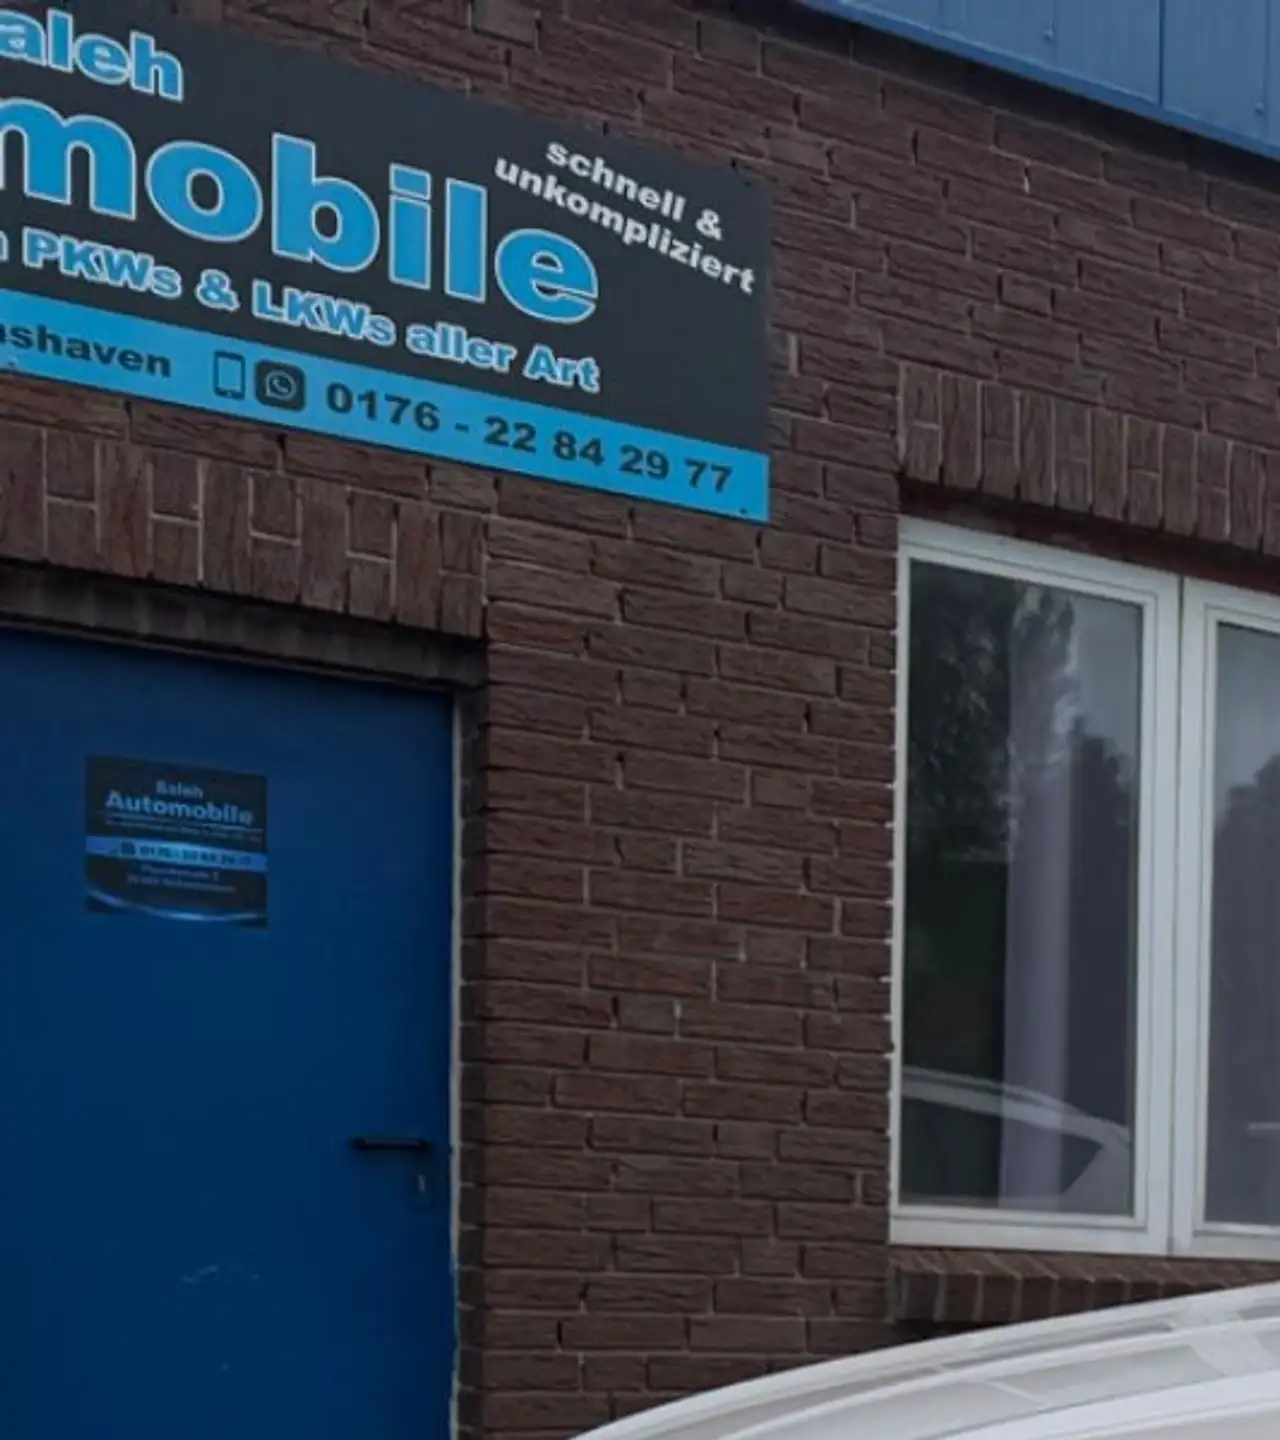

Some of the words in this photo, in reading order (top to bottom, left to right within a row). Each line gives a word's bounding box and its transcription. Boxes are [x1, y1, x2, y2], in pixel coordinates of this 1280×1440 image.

[0, 97, 599, 324] mobile
[494, 157, 755, 294] unkompliziert
[546, 141, 686, 222] schnell
[695, 208, 724, 241] &
[22, 226, 182, 298] PKWs
[195, 268, 241, 312] &
[252, 279, 397, 347] LKWs
[406, 322, 517, 373] aller
[523, 344, 600, 393] Art
[0, 323, 171, 378] shaven
[326, 382, 440, 432] 0176
[484, 416, 537, 454] 22
[552, 431, 606, 466] 84
[619, 444, 670, 480] 29
[684, 459, 733, 493] 77
